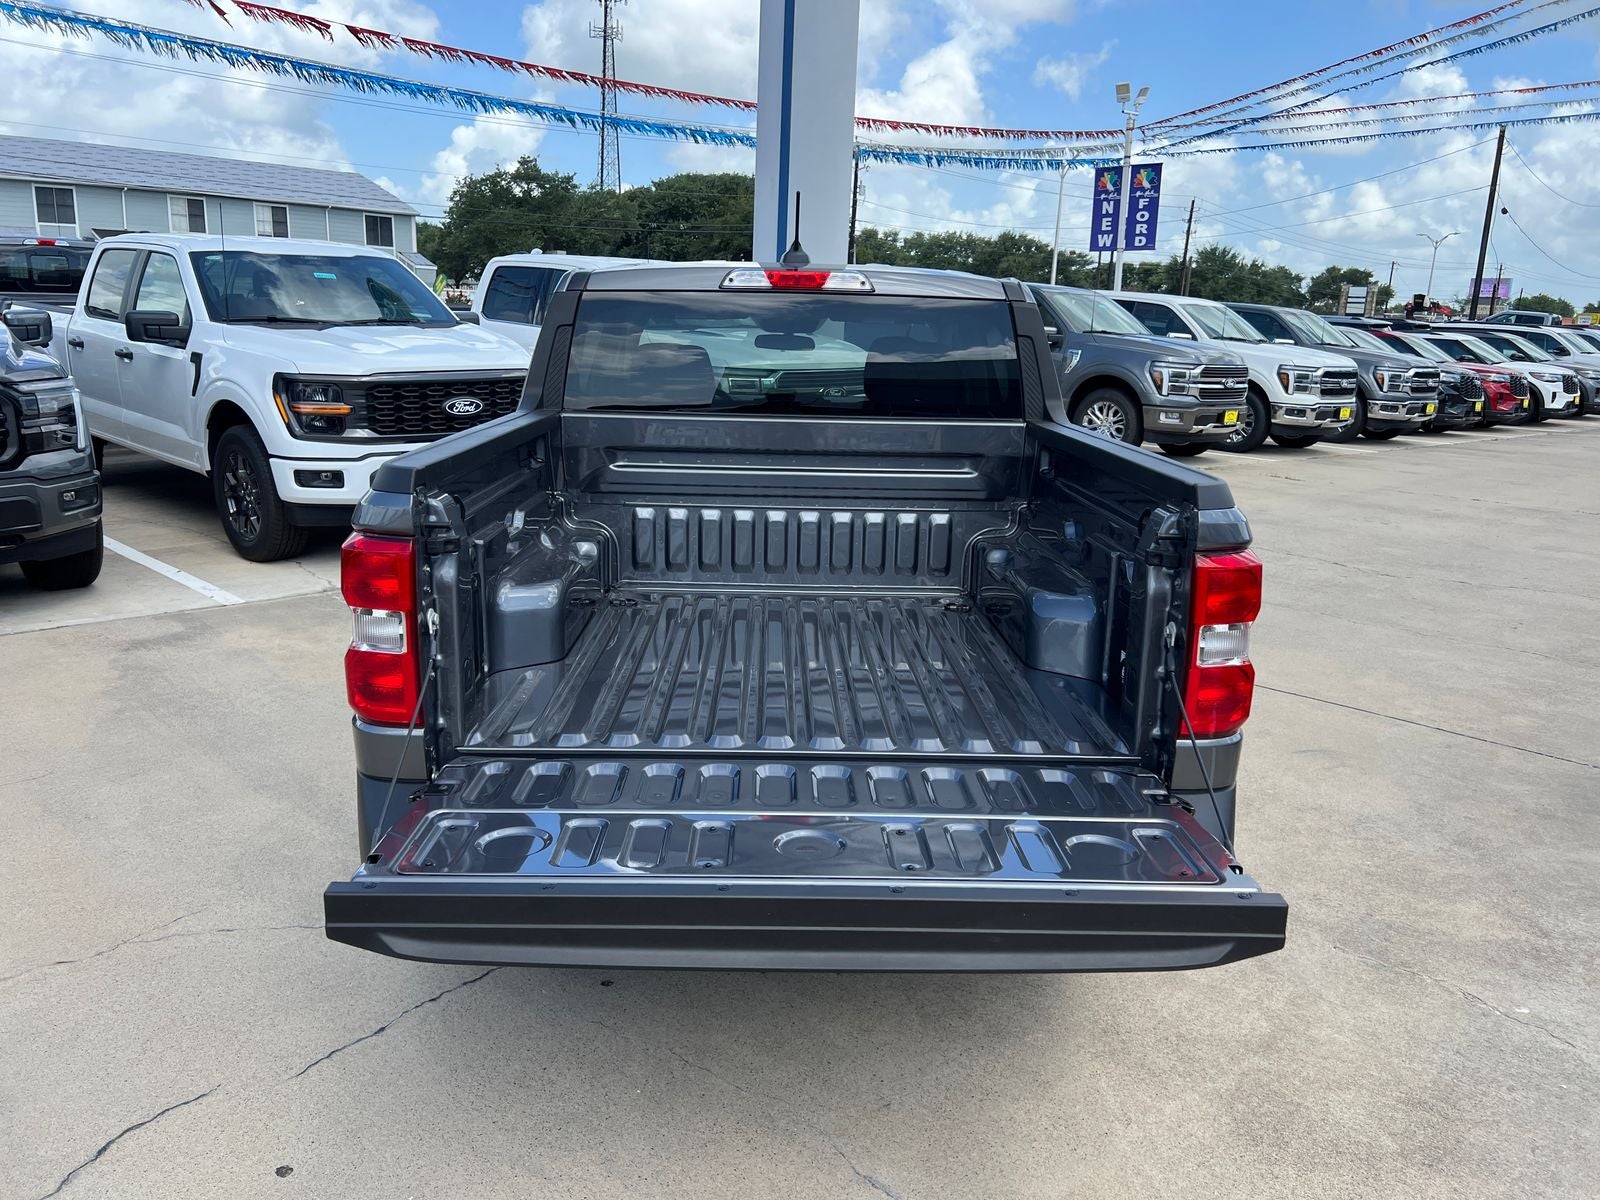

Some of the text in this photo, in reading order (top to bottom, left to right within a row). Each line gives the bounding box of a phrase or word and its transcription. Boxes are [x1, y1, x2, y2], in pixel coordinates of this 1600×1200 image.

[1097, 200, 1114, 247] NEW
[1134, 198, 1150, 247] FORD
[453, 401, 476, 413] Ford
